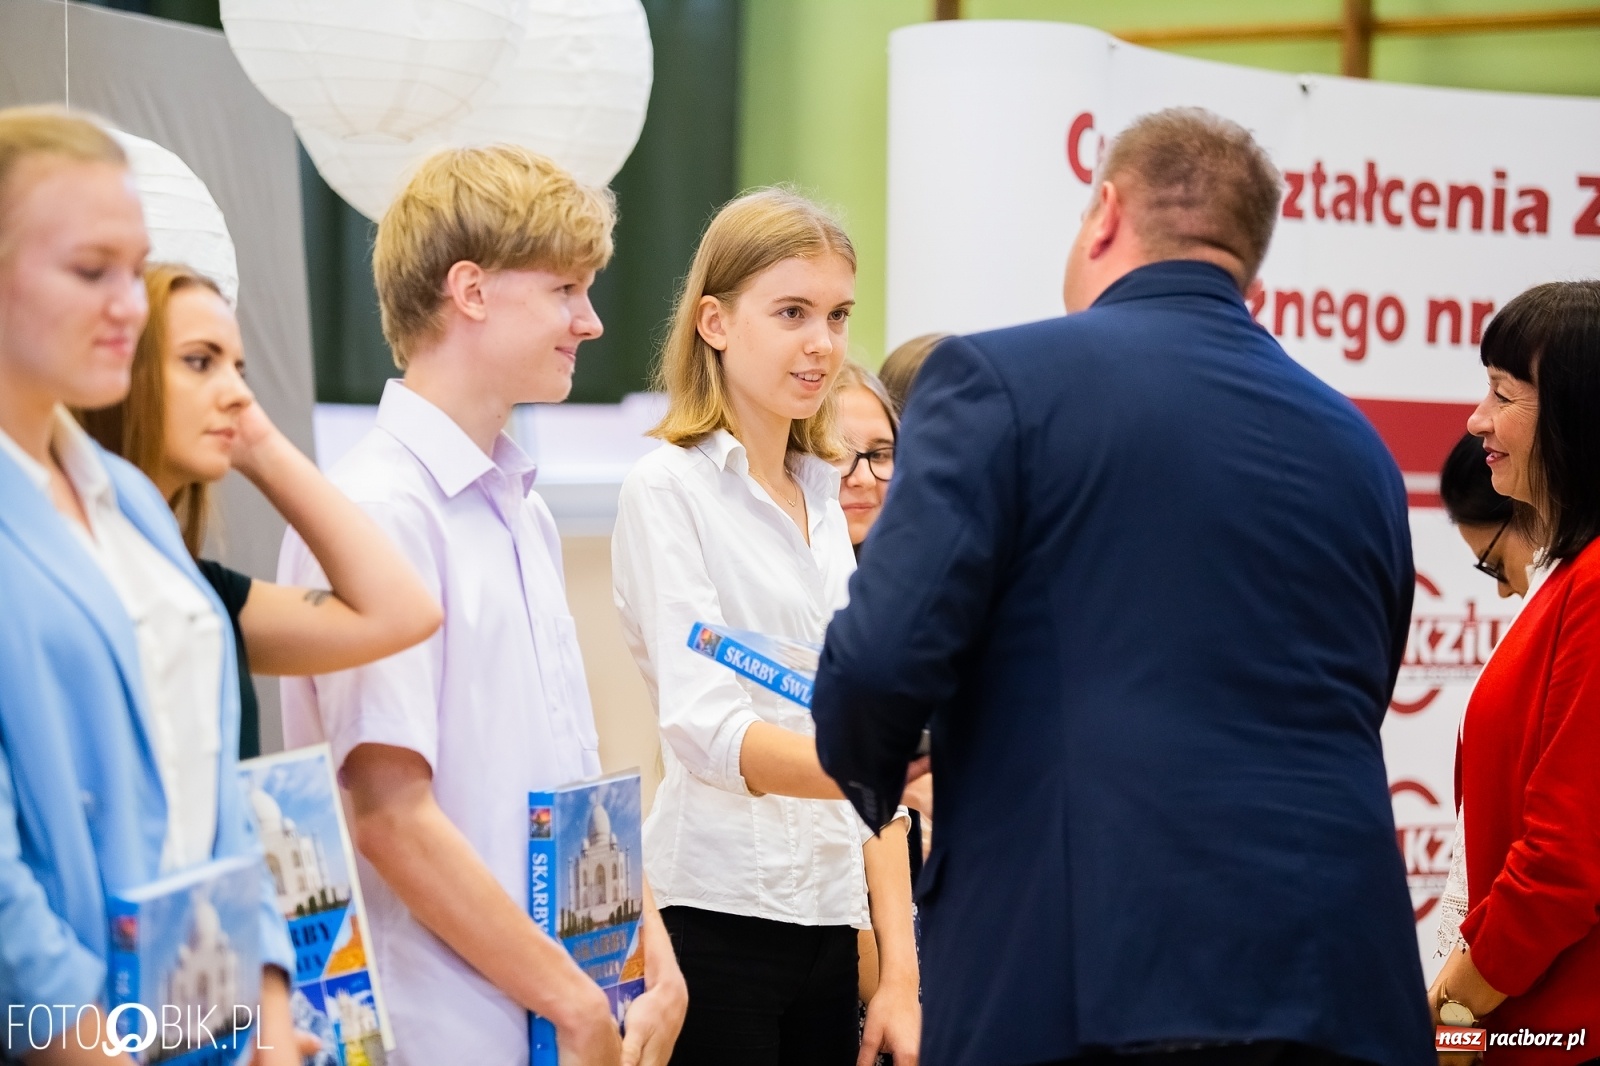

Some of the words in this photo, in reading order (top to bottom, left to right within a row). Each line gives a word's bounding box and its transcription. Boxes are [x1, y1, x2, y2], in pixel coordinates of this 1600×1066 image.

[1281, 161, 1550, 236] ztałcenia
[1574, 175, 1600, 236] Z
[1427, 299, 1494, 345] nr
[724, 645, 779, 685] SKARBY
[779, 672, 814, 704] ŚWI
